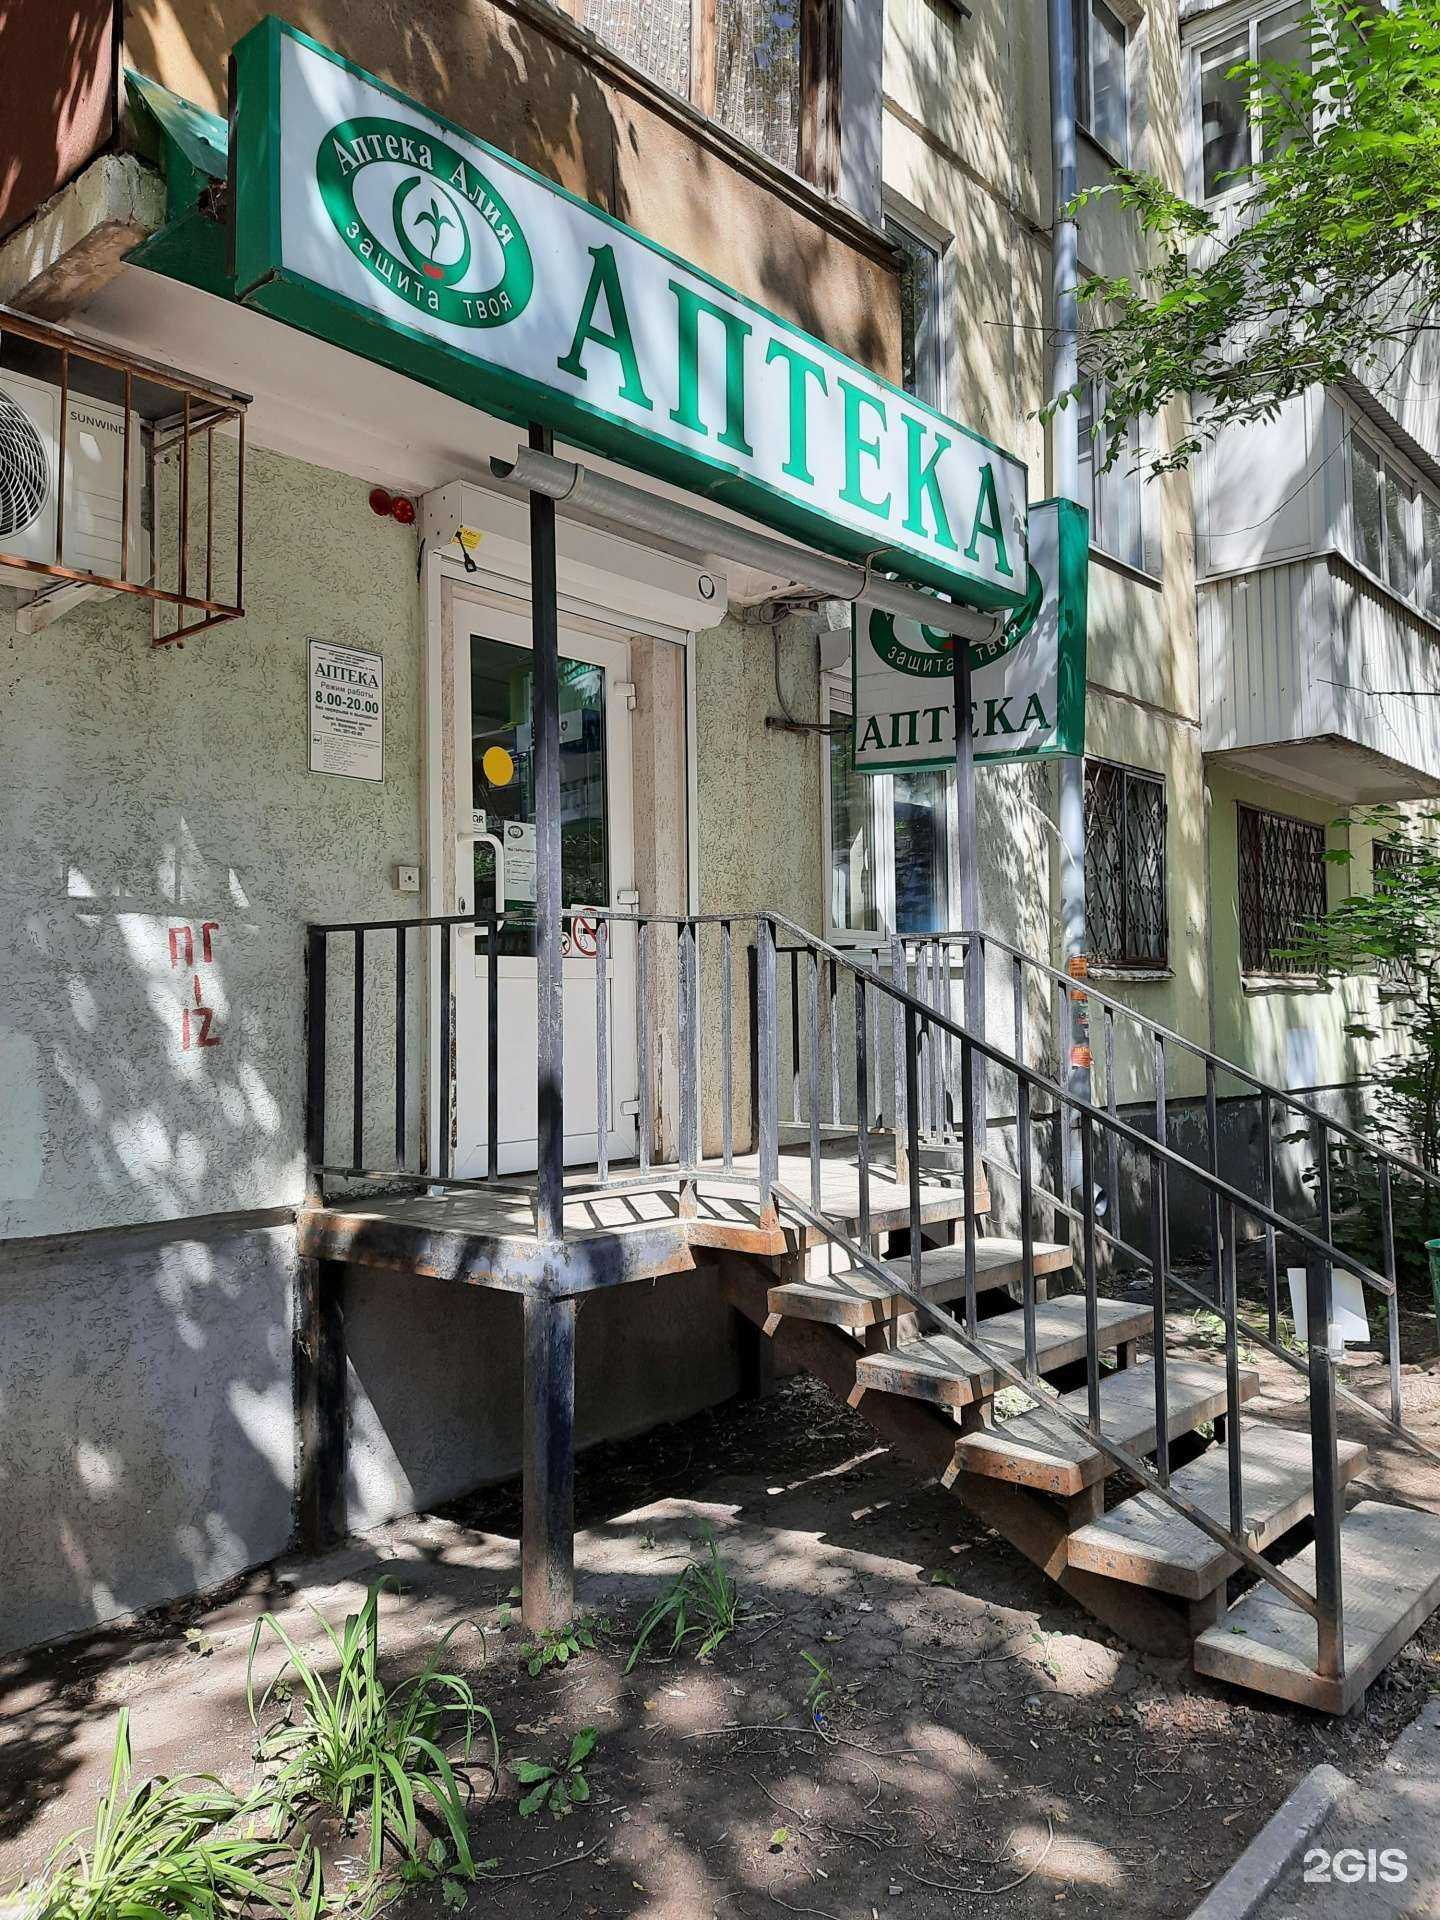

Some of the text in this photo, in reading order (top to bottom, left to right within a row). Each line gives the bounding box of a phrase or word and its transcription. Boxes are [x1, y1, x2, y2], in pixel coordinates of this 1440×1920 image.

[333, 134, 515, 247] Аптека Алия
[346, 222, 513, 319] защита твоя
[557, 243, 1014, 578] АПТЕКА
[314, 662, 379, 688] АПТЕКА
[315, 690, 379, 714] 8.00-20.00
[320, 681, 374, 699] Режим работы
